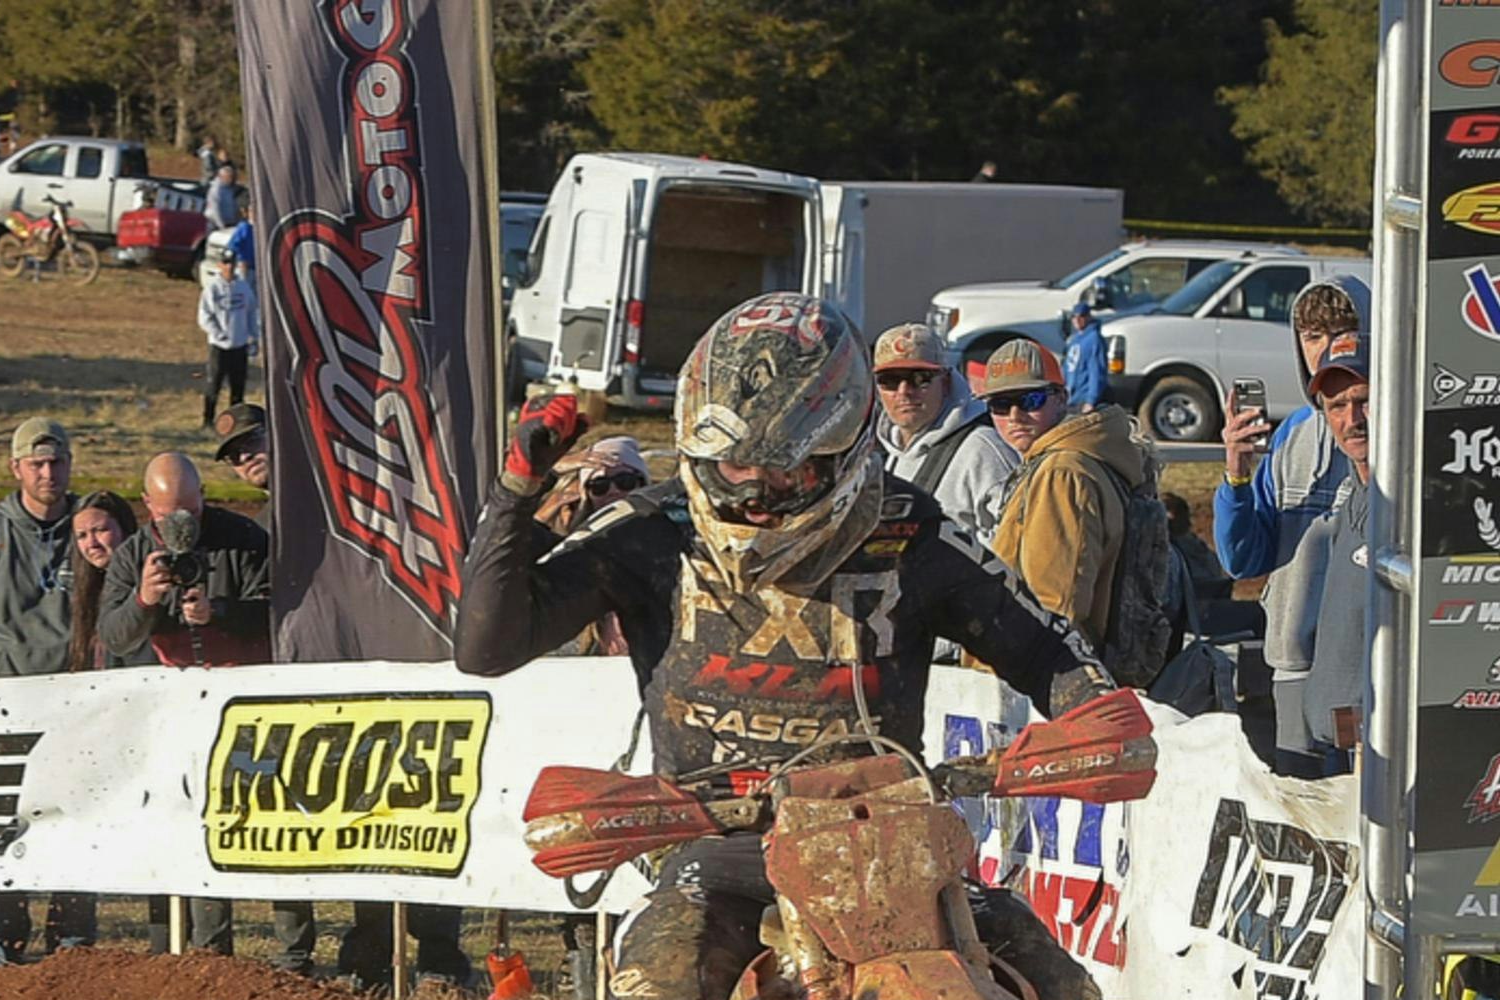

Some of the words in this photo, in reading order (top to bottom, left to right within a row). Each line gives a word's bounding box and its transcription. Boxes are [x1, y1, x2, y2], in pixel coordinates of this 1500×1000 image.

[680, 552, 903, 662] FXR
[684, 703, 883, 744] GASGAS
[217, 720, 474, 815] MOOSE
[219, 827, 325, 852] UTILITY
[336, 825, 459, 854] DIVISION
